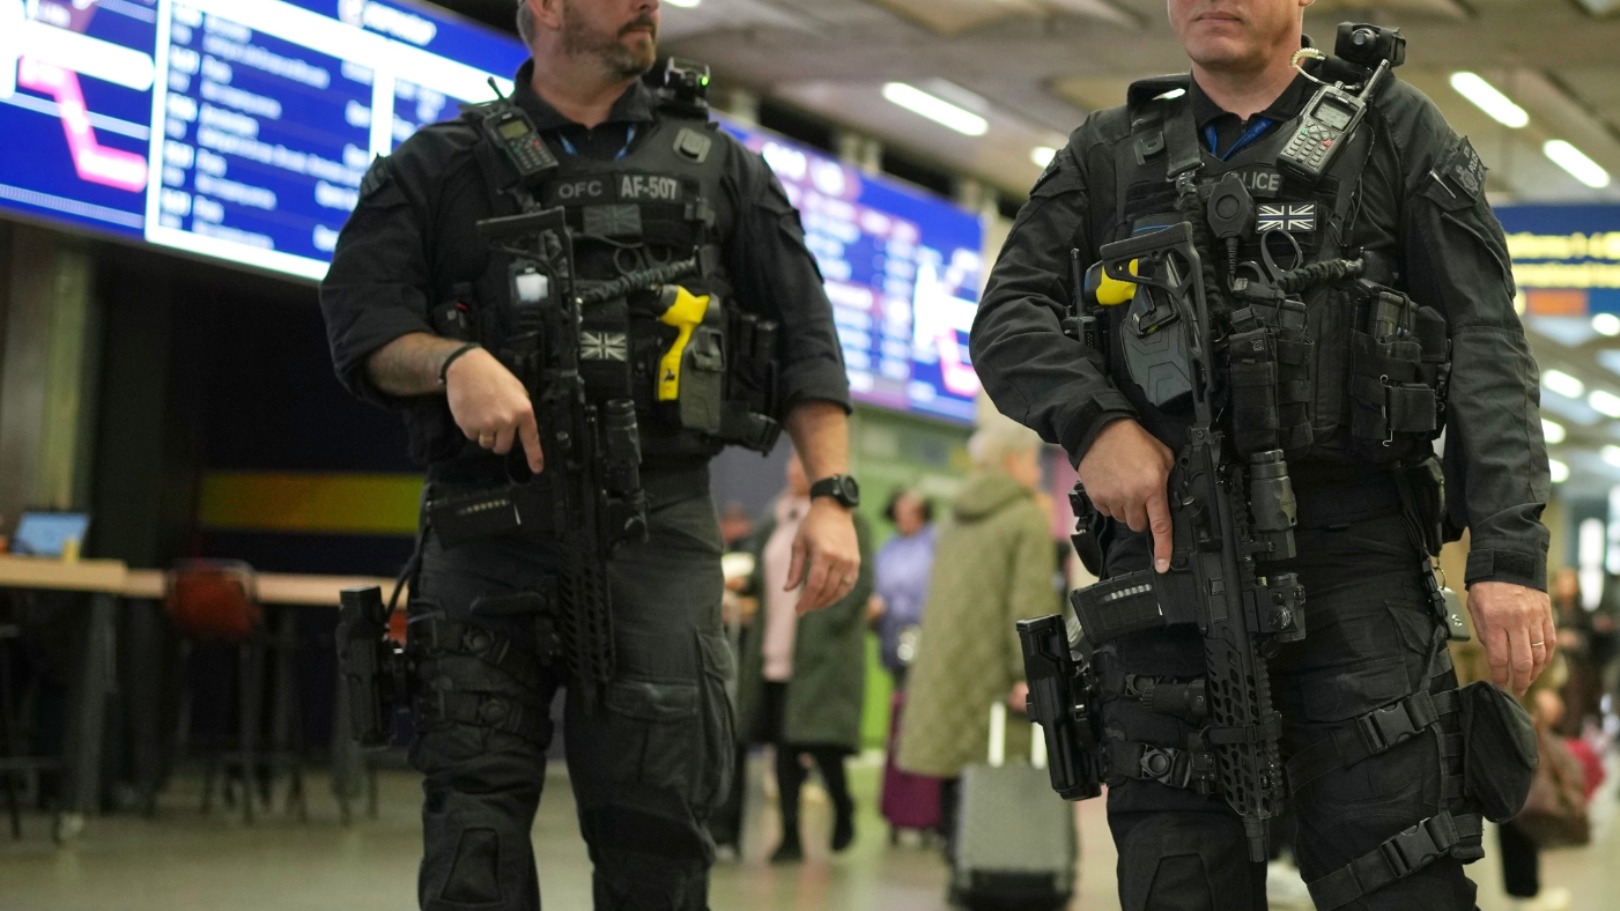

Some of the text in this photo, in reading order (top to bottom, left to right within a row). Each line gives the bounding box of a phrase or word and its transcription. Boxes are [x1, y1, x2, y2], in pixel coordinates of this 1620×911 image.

[559, 175, 677, 200] OFC AF-507
[1242, 171, 1280, 191] LICE
